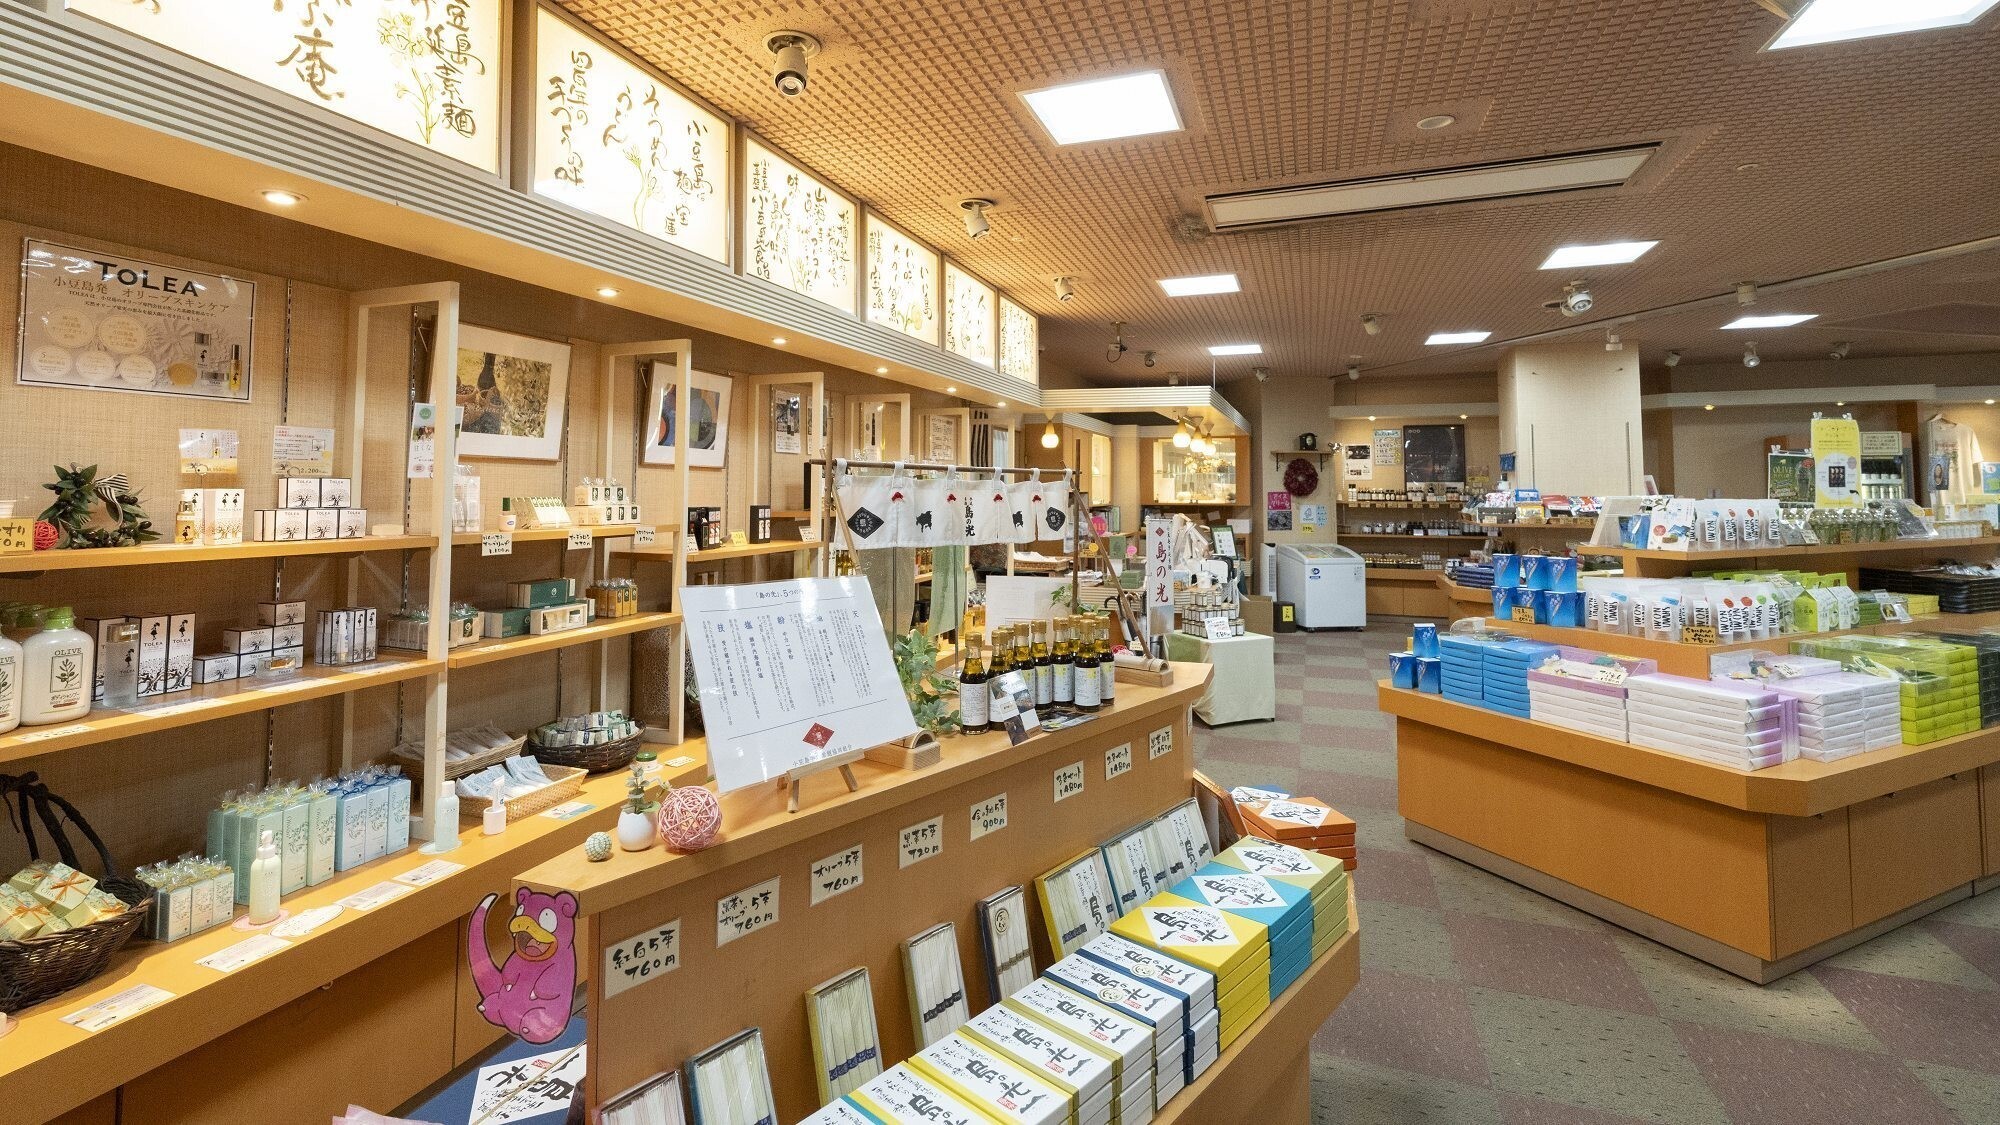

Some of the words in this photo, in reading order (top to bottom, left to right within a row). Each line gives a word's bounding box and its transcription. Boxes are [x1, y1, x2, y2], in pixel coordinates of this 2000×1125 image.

[93, 260, 199, 298] TOLEA
[52, 275, 108, 296] 小豆島発
[122, 288, 231, 313] オリーブスキンケア
[965, 505, 976, 537] 島の光
[1155, 541, 1169, 603] 島の光
[717, 623, 725, 633] 技
[744, 620, 753, 630] 塩
[777, 616, 785, 625] 粉
[1653, 607, 1661, 630] NOMI
[54, 647, 82, 656] OLIVE
[982, 817, 1005, 832] 900円
[908, 845, 939, 860] 720円
[1243, 850, 1313, 873] 島の光
[823, 875, 859, 892] 760円
[1204, 879, 1277, 905] 島の光
[734, 912, 773, 934] 760円
[1153, 911, 1229, 942] 島の光
[612, 929, 675, 970] 紅白5束
[1124, 949, 1183, 976] 島の光
[624, 954, 675, 980] 760円
[1091, 971, 1150, 1001] 島の光
[1056, 999, 1119, 1032] 島の光
[1012, 1027, 1077, 1063] 島の光
[485, 1063, 575, 1101] 島光
[965, 1059, 1031, 1099] 島の光
